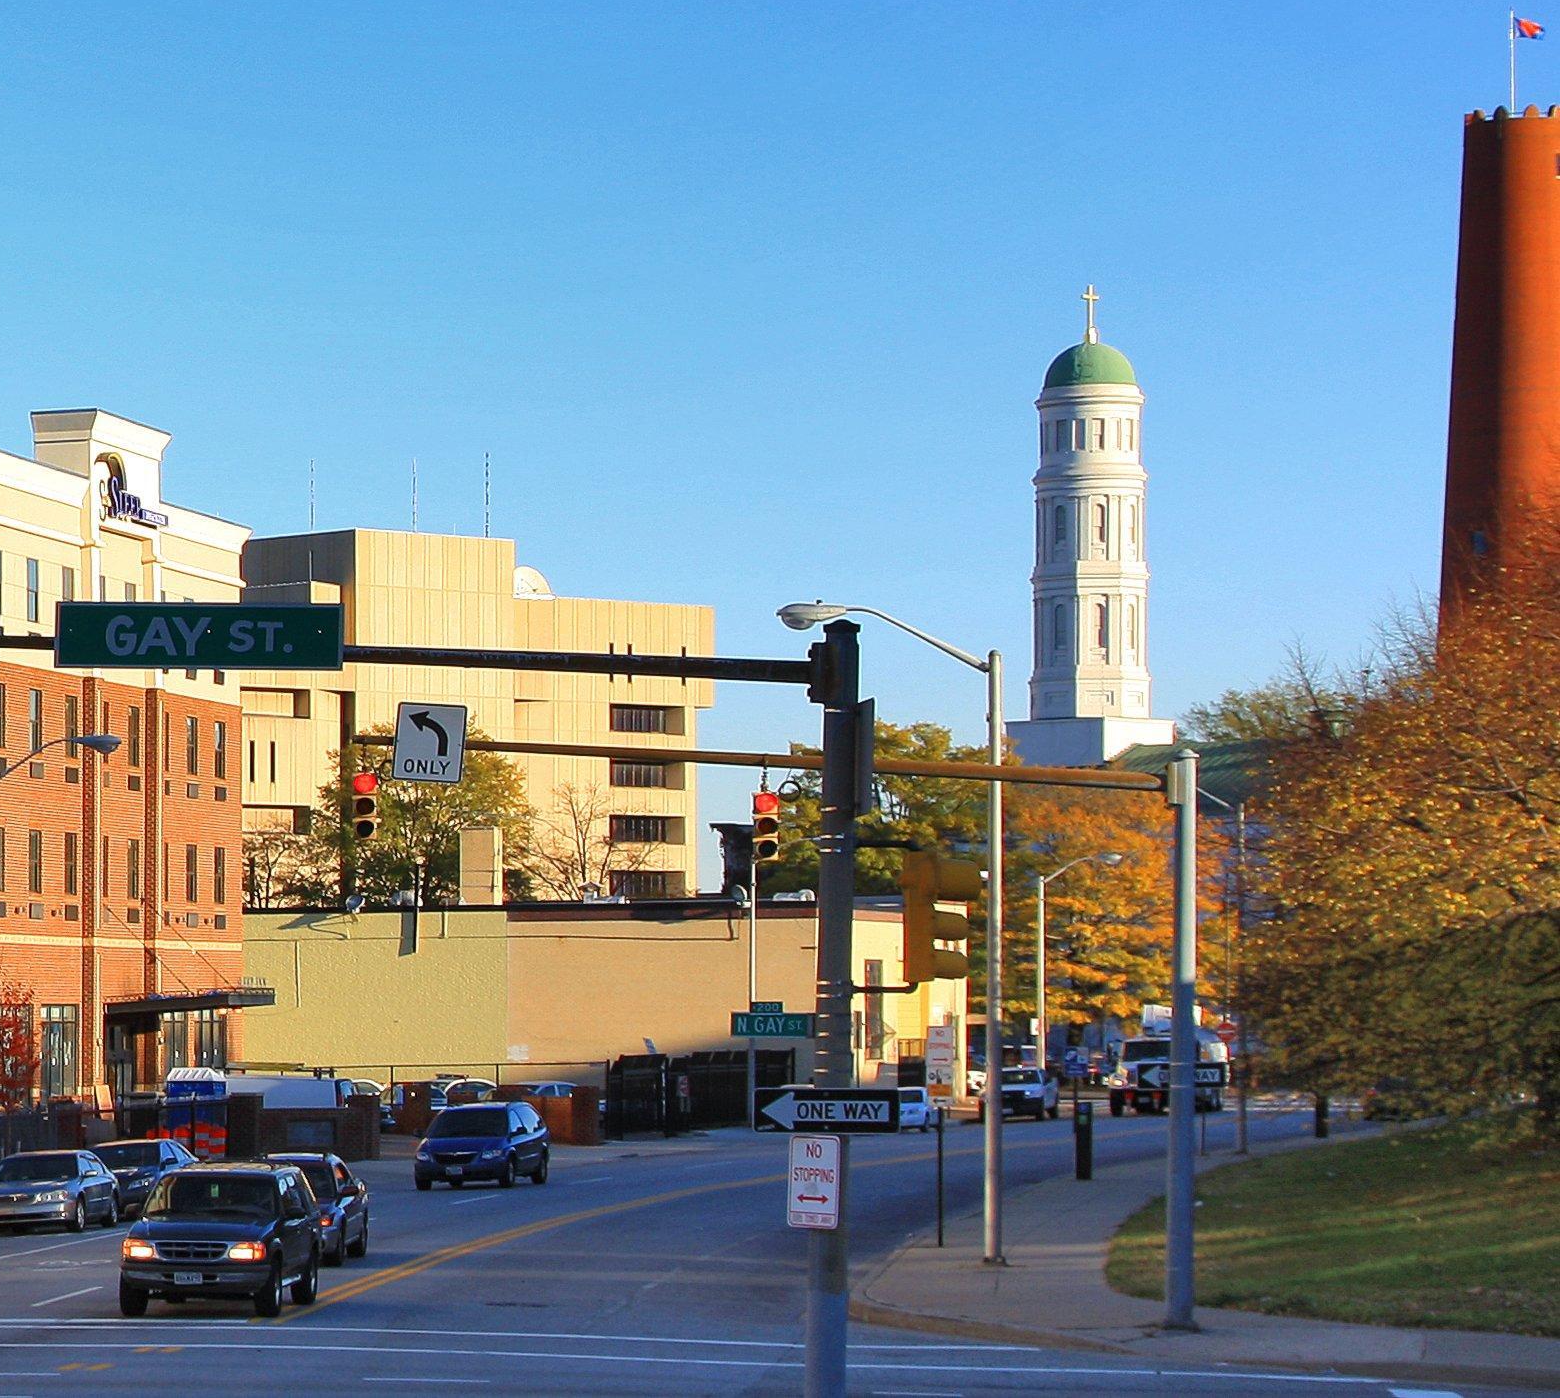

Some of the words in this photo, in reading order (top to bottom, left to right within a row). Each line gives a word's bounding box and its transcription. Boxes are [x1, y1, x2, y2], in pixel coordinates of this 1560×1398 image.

[105, 615, 213, 656] GAY
[227, 620, 293, 654] ST.
[403, 758, 451, 777] ONLY
[754, 1016, 787, 1033] GAY
[796, 1102, 836, 1120] ONE
[843, 1102, 884, 1120] WAY
[805, 1143, 823, 1159] NO
[793, 1167, 835, 1184] STOPPING
